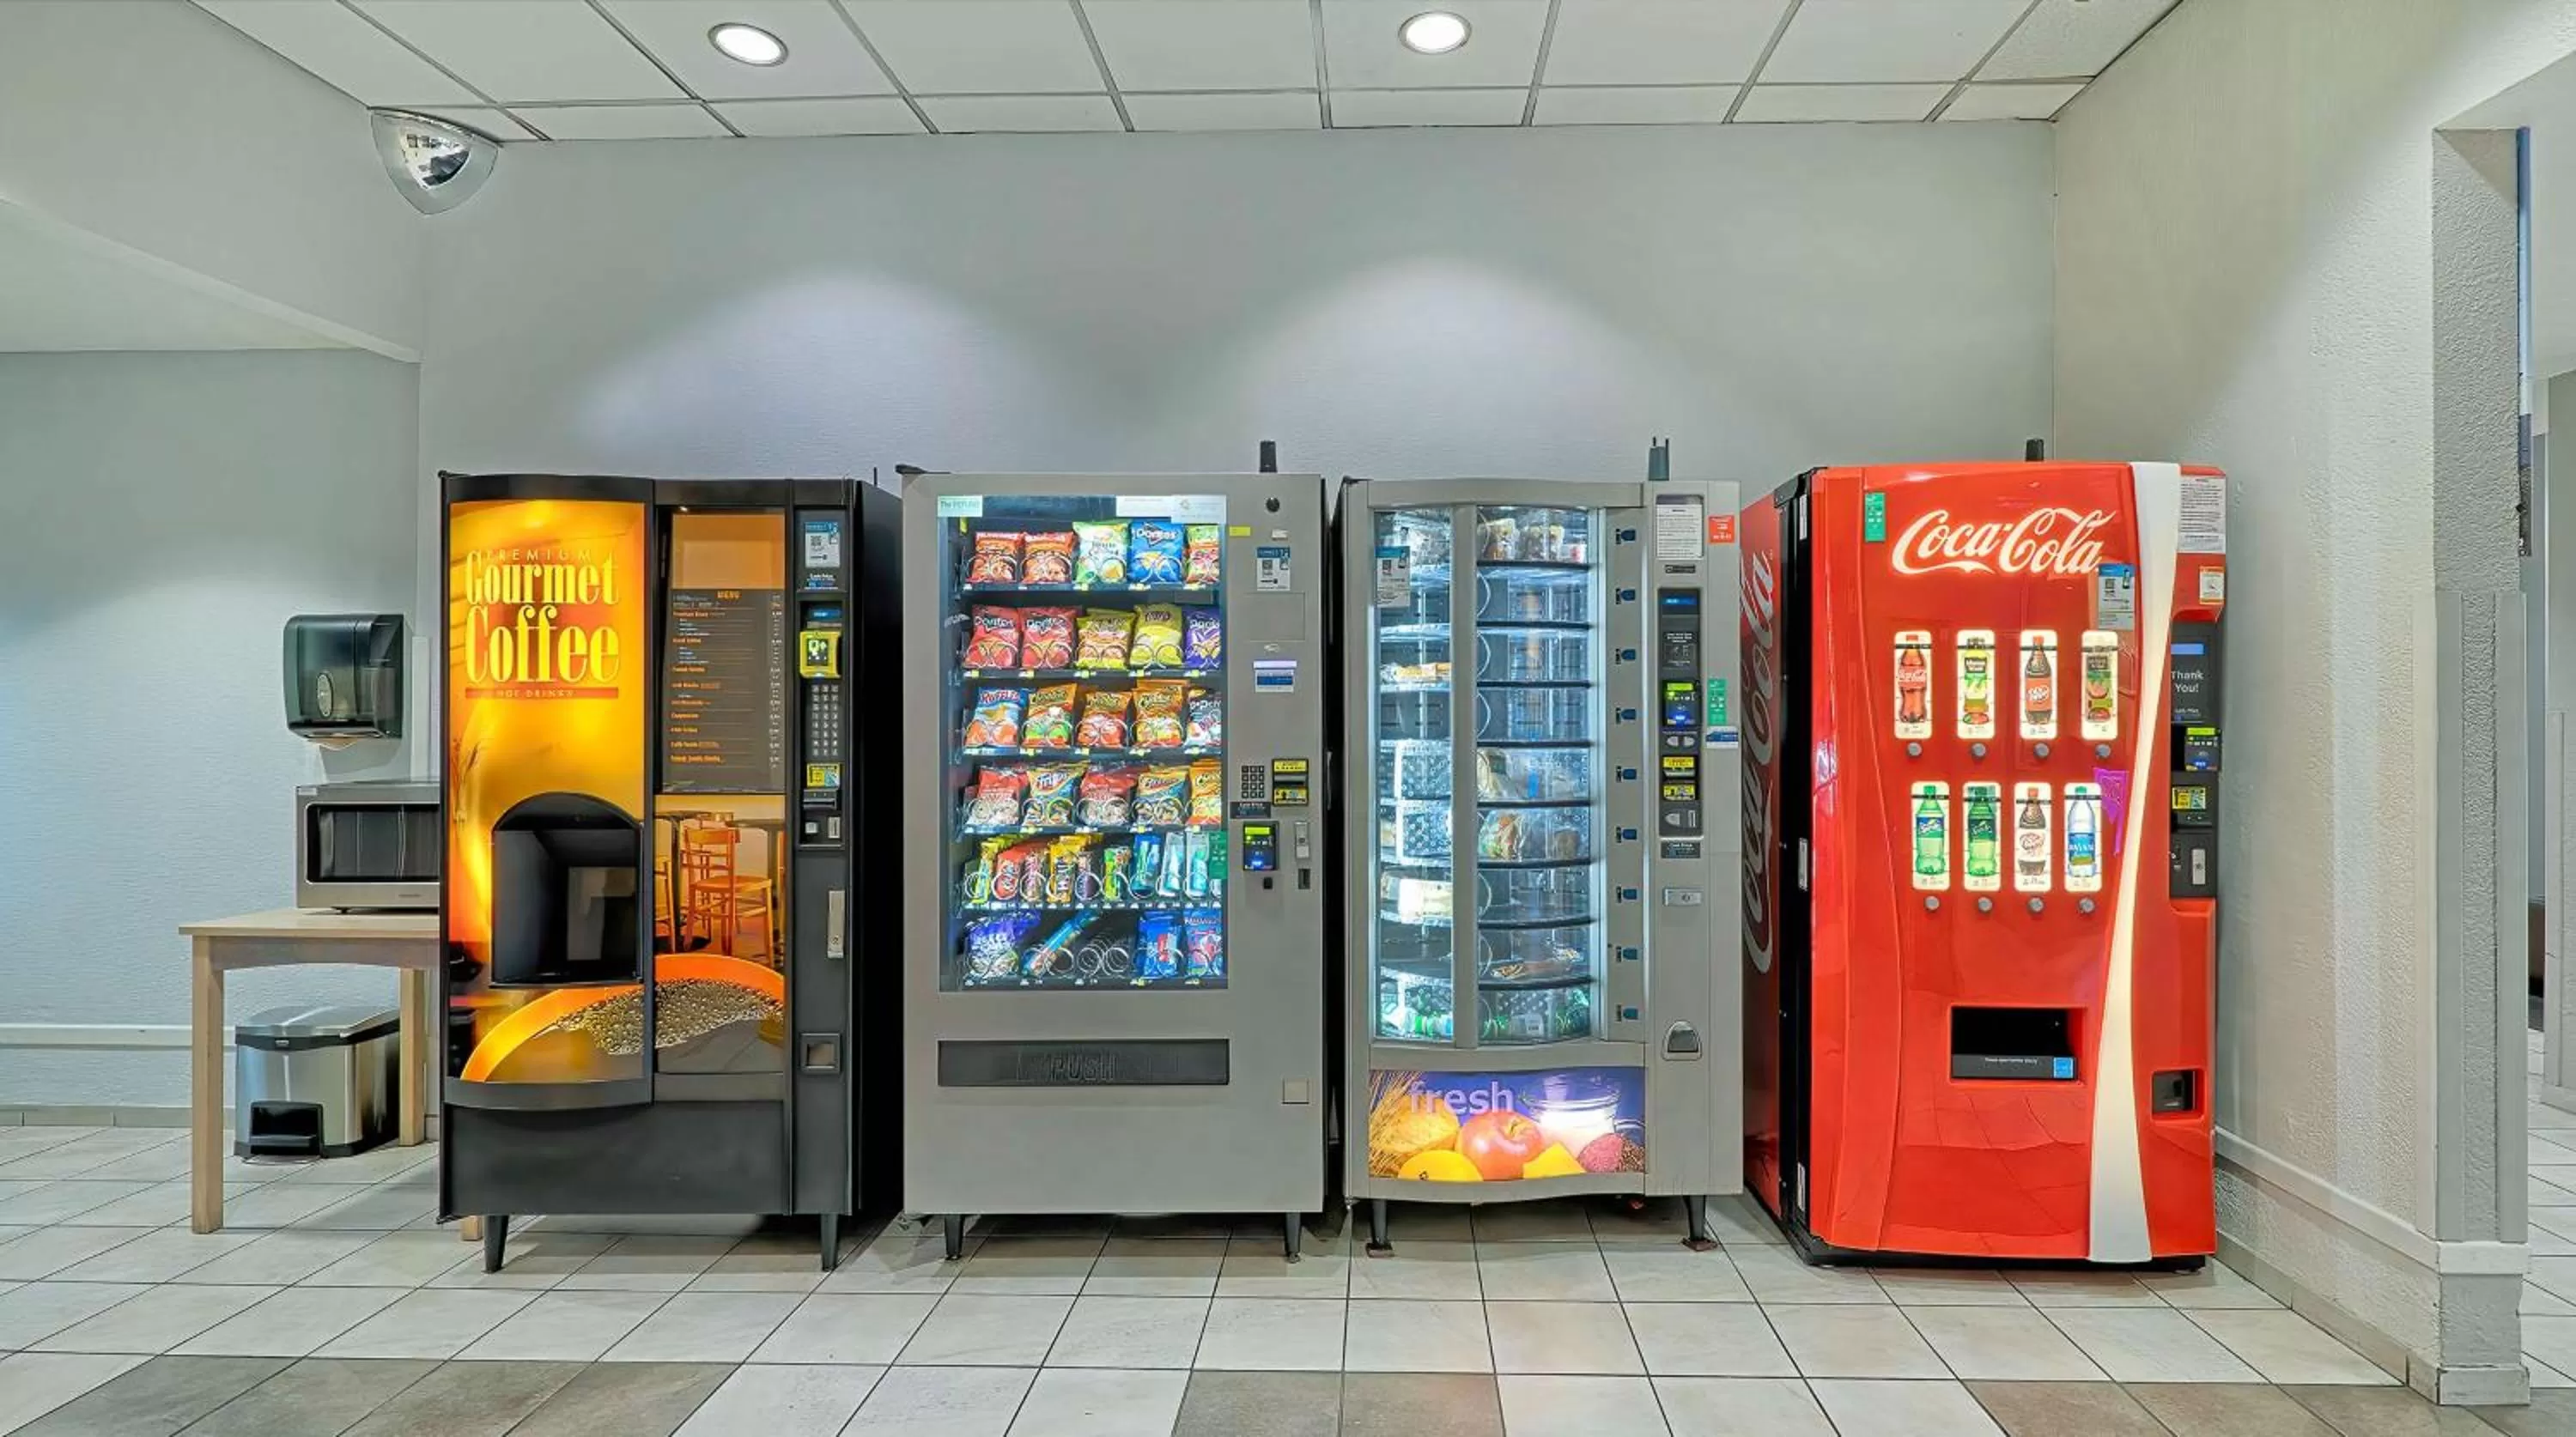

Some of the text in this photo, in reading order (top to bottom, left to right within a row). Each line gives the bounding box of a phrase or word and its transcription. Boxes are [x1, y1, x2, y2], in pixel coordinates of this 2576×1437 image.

[1892, 507, 2115, 573] Coca-Cola
[465, 550, 619, 605] Gourmet
[465, 604, 619, 683] Coffee
[2171, 670, 2204, 680] Thank
[2174, 683, 2199, 693] You!
[1741, 549, 1773, 974] CocaCola
[1408, 1080, 1514, 1113] fresh
